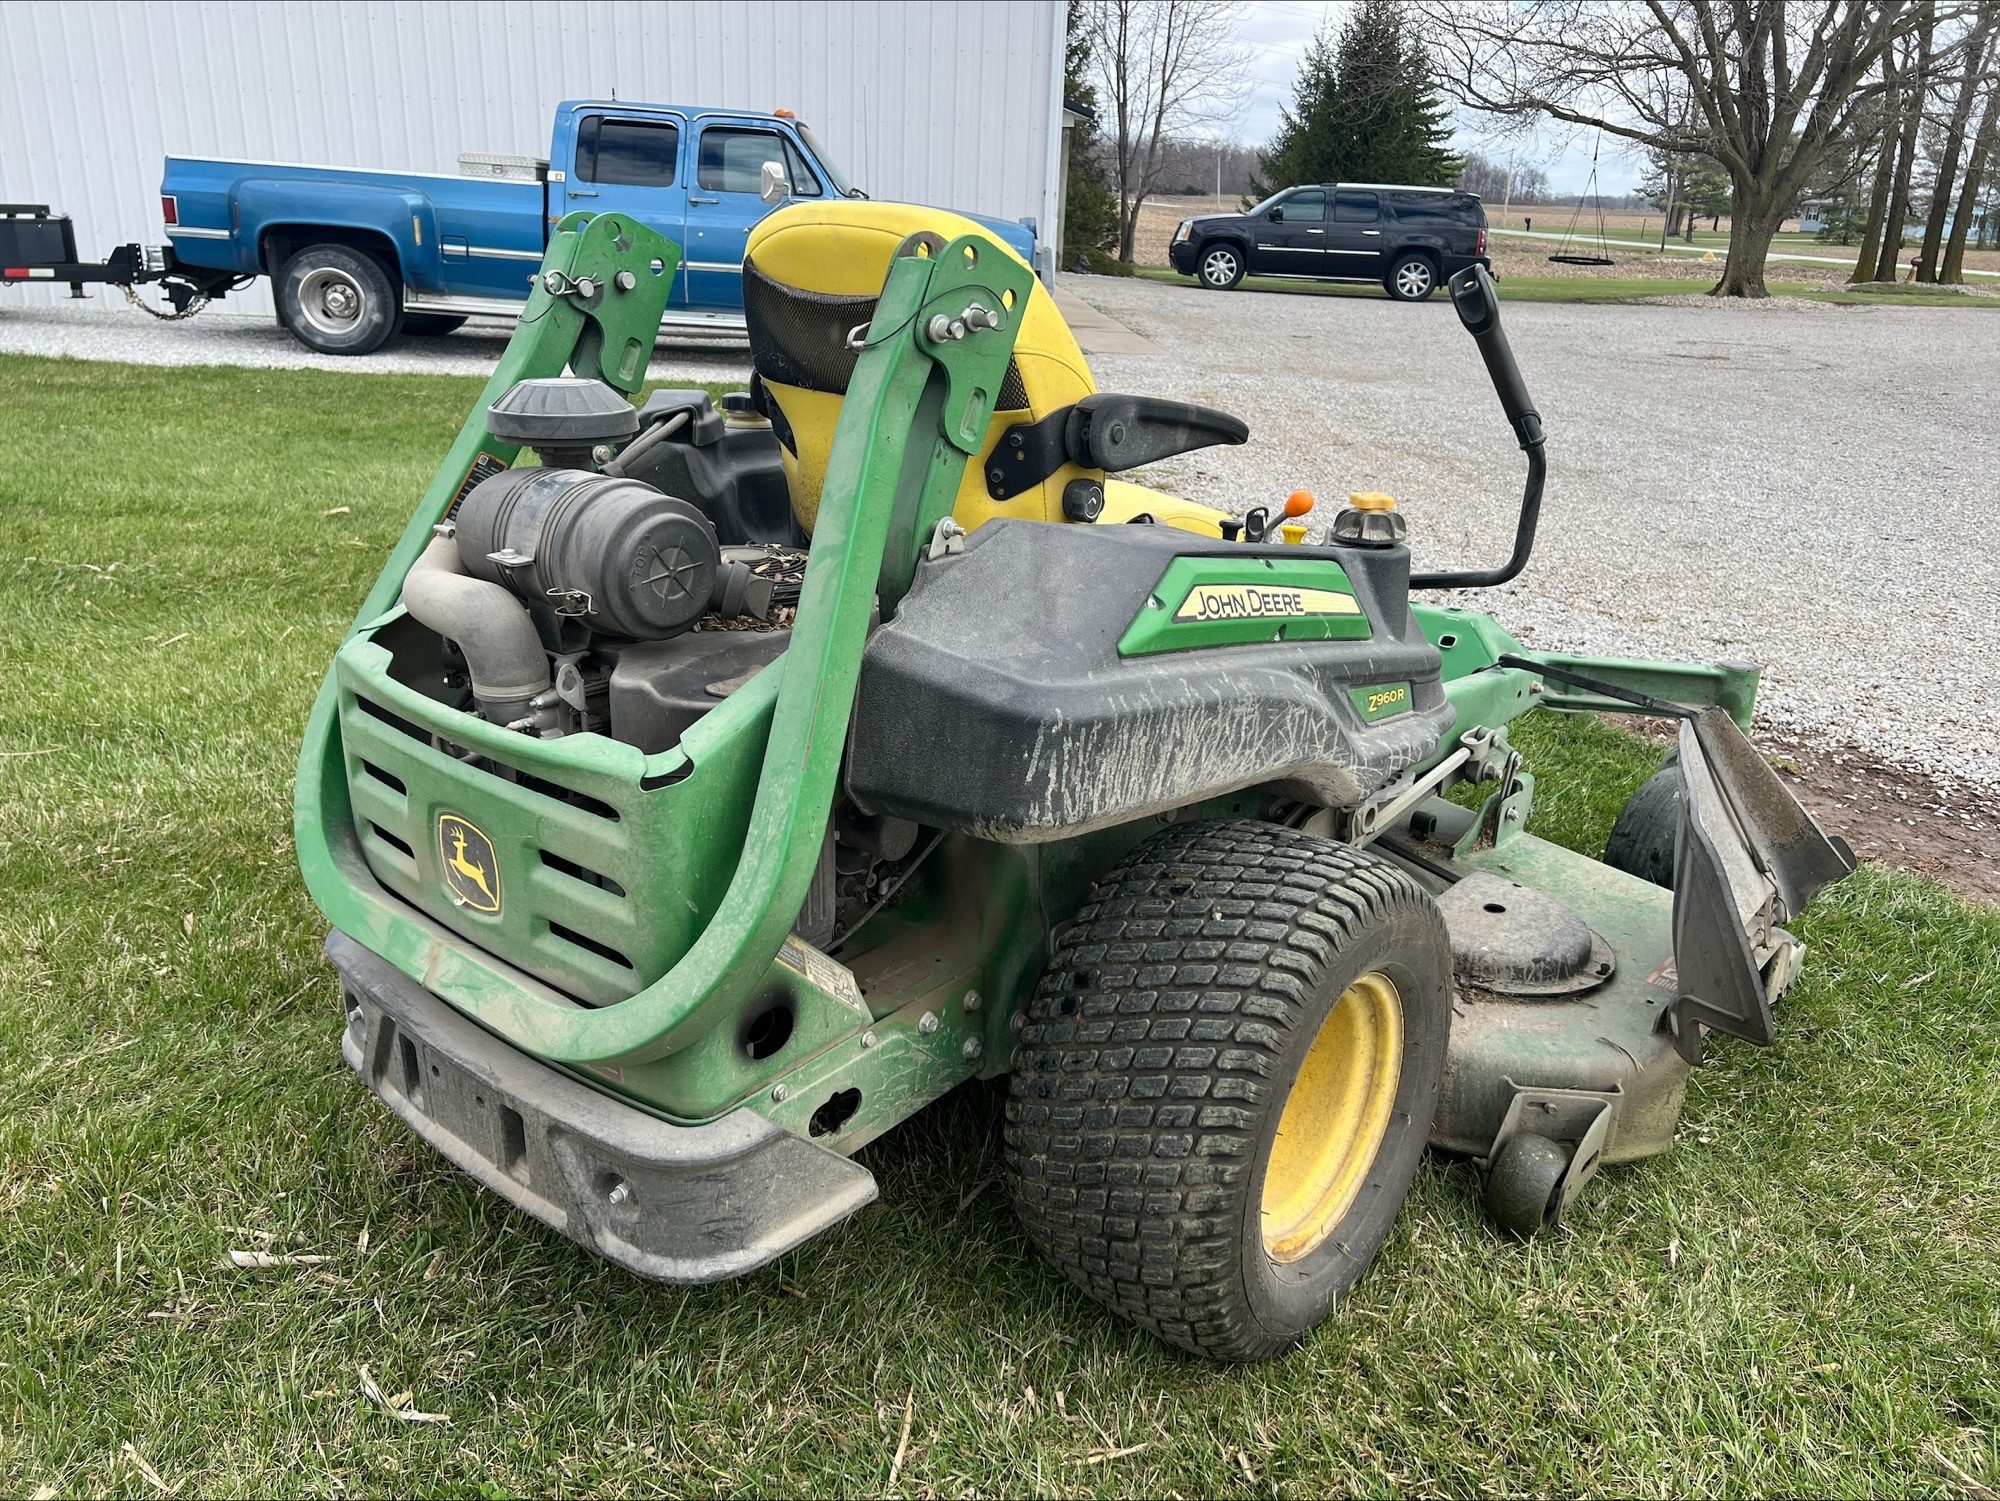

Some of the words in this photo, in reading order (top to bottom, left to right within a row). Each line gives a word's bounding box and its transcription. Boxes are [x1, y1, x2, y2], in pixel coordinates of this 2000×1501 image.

[631, 546, 648, 578] TOP
[1198, 591, 1246, 616] JOHN
[1246, 589, 1304, 613] DEERE
[1368, 688, 1405, 712] Z960R
